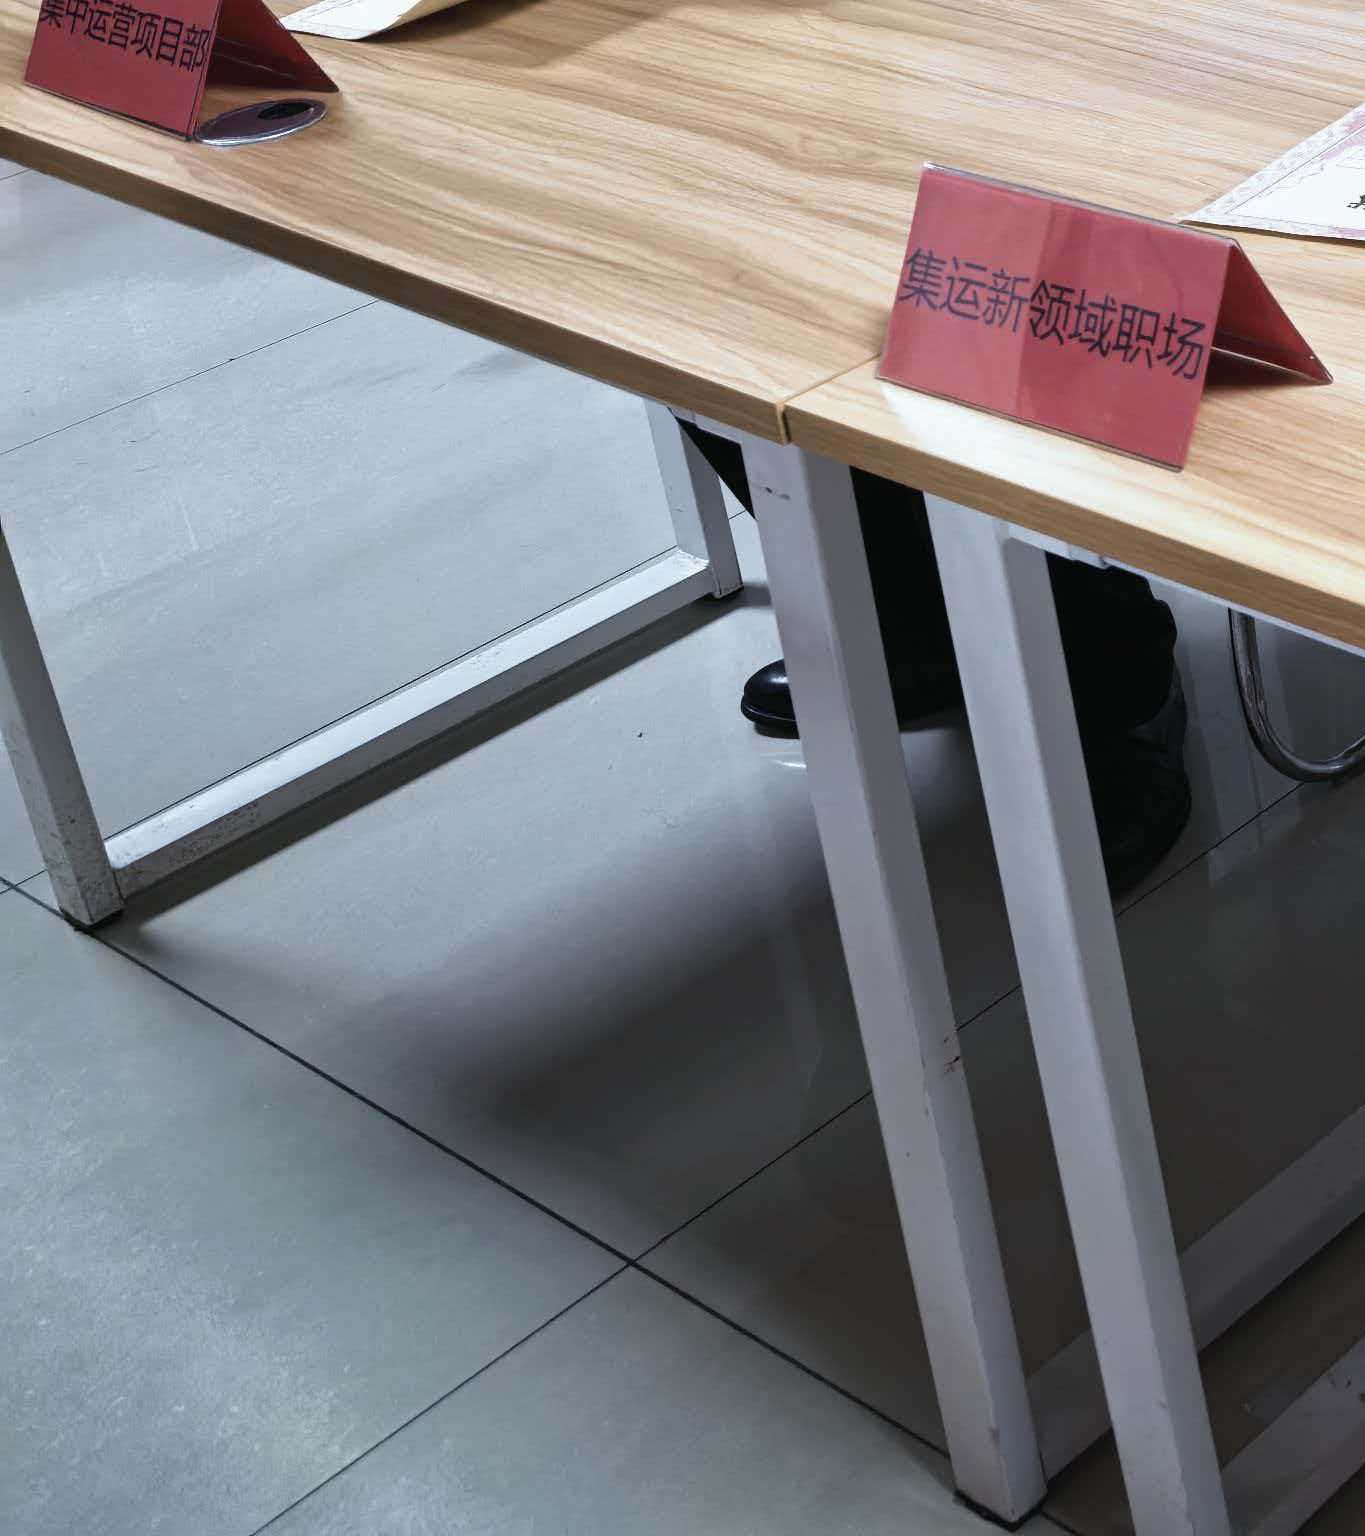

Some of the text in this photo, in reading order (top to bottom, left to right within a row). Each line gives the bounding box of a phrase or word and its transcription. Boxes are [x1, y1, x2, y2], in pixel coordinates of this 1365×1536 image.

[898, 247, 1207, 380] 集运新领域职场
